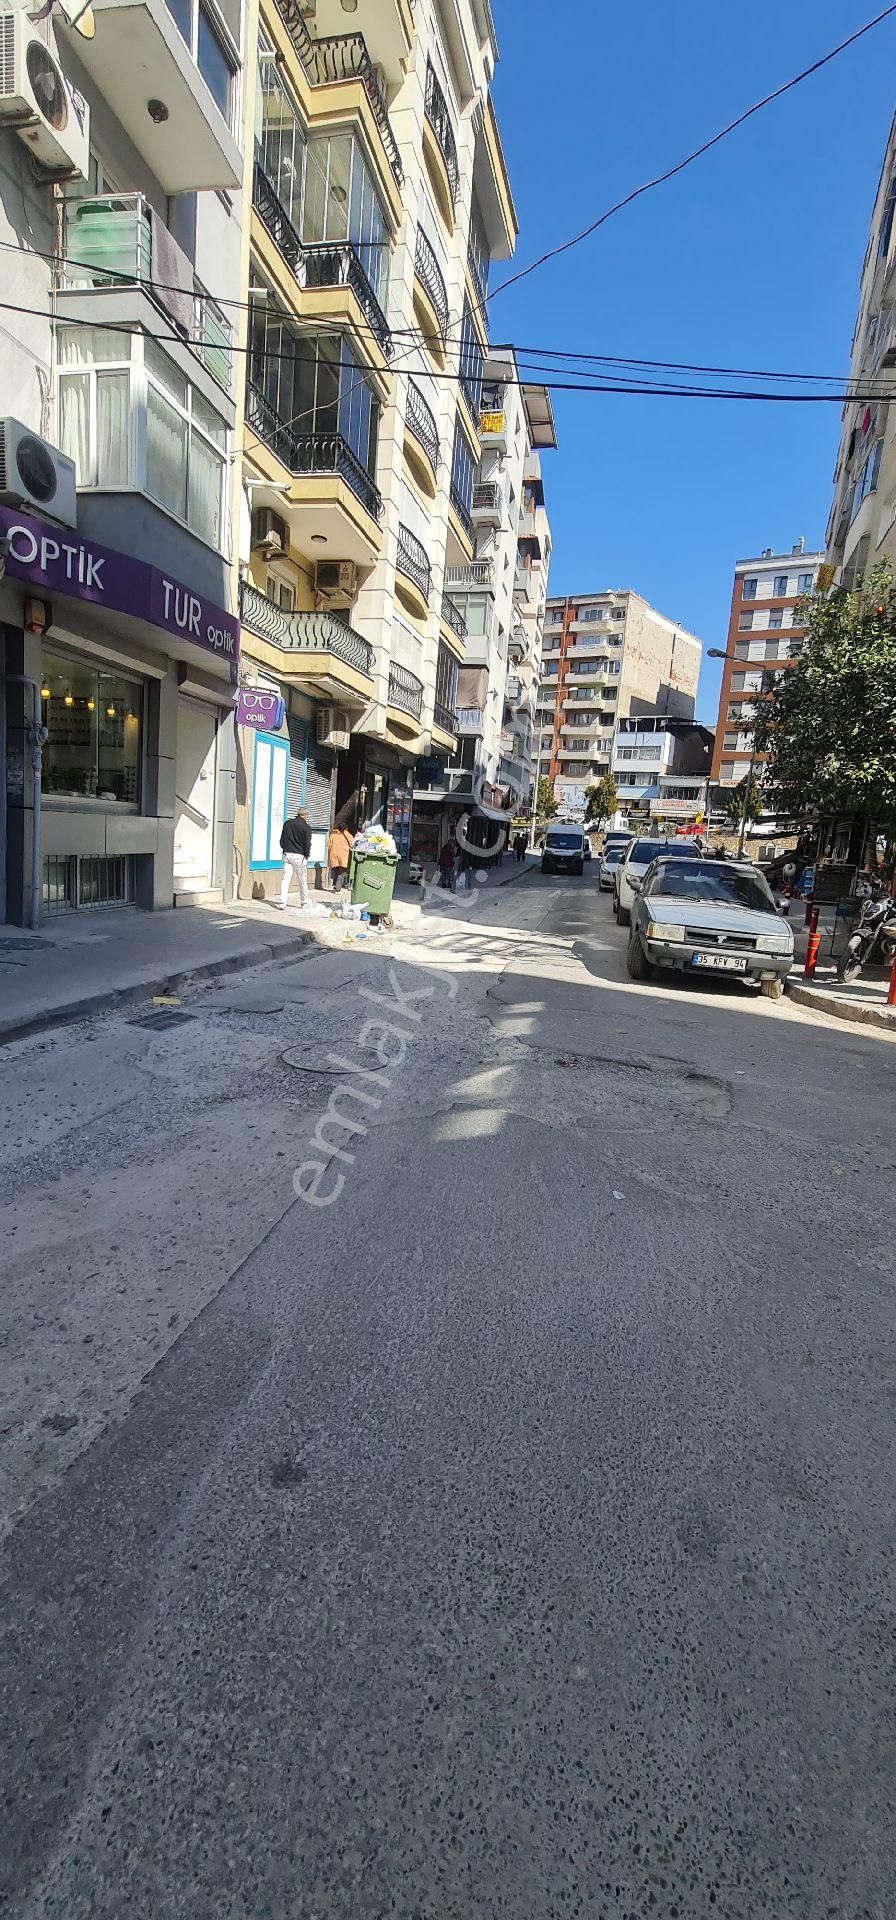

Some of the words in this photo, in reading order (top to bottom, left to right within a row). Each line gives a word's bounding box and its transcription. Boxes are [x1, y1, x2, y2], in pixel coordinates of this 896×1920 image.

[6, 525, 105, 590] OPTİK
[162, 579, 202, 636] TUR
[207, 625, 235, 654] optik
[698, 955, 708, 964] 35
[734, 959, 744, 968] 94
